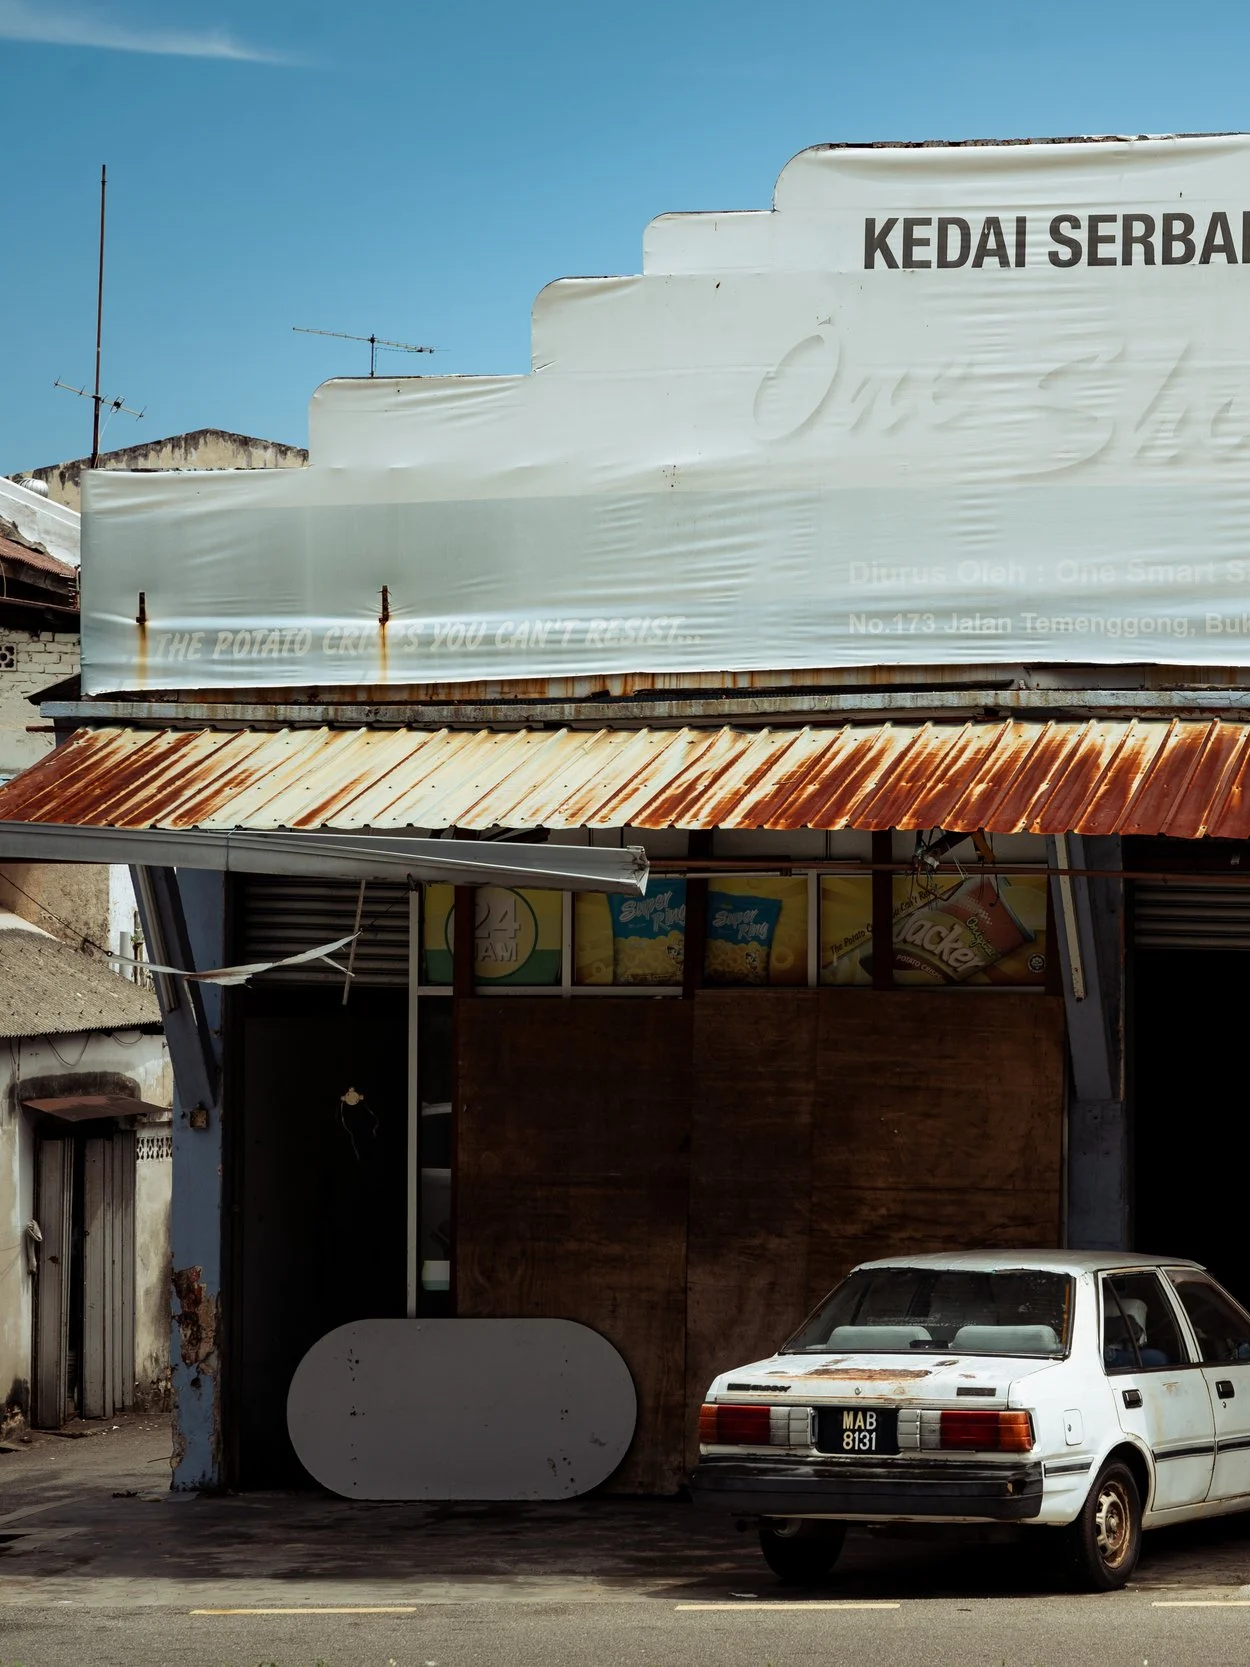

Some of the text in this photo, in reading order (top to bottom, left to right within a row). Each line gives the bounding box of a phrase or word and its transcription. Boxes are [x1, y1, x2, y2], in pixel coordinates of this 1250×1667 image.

[864, 216, 1027, 269] KEDAI
[957, 559, 1024, 584] Oleh
[1056, 559, 1116, 584] One
[1126, 558, 1215, 584] Smart
[848, 613, 936, 634] No.173
[944, 612, 1012, 633] Jalan
[1020, 612, 1195, 638] Temenggong,
[155, 631, 205, 662] THE
[212, 626, 312, 660] POTATO
[429, 620, 487, 651] YOU
[495, 618, 580, 650] CAN'T
[619, 890, 673, 922] Super
[712, 908, 759, 929] Super
[737, 921, 769, 941] Ring
[829, 930, 866, 955] The Potato
[896, 954, 921, 968] POTATO
[843, 1411, 876, 1430] MAB
[843, 1431, 876, 1451] 8131
